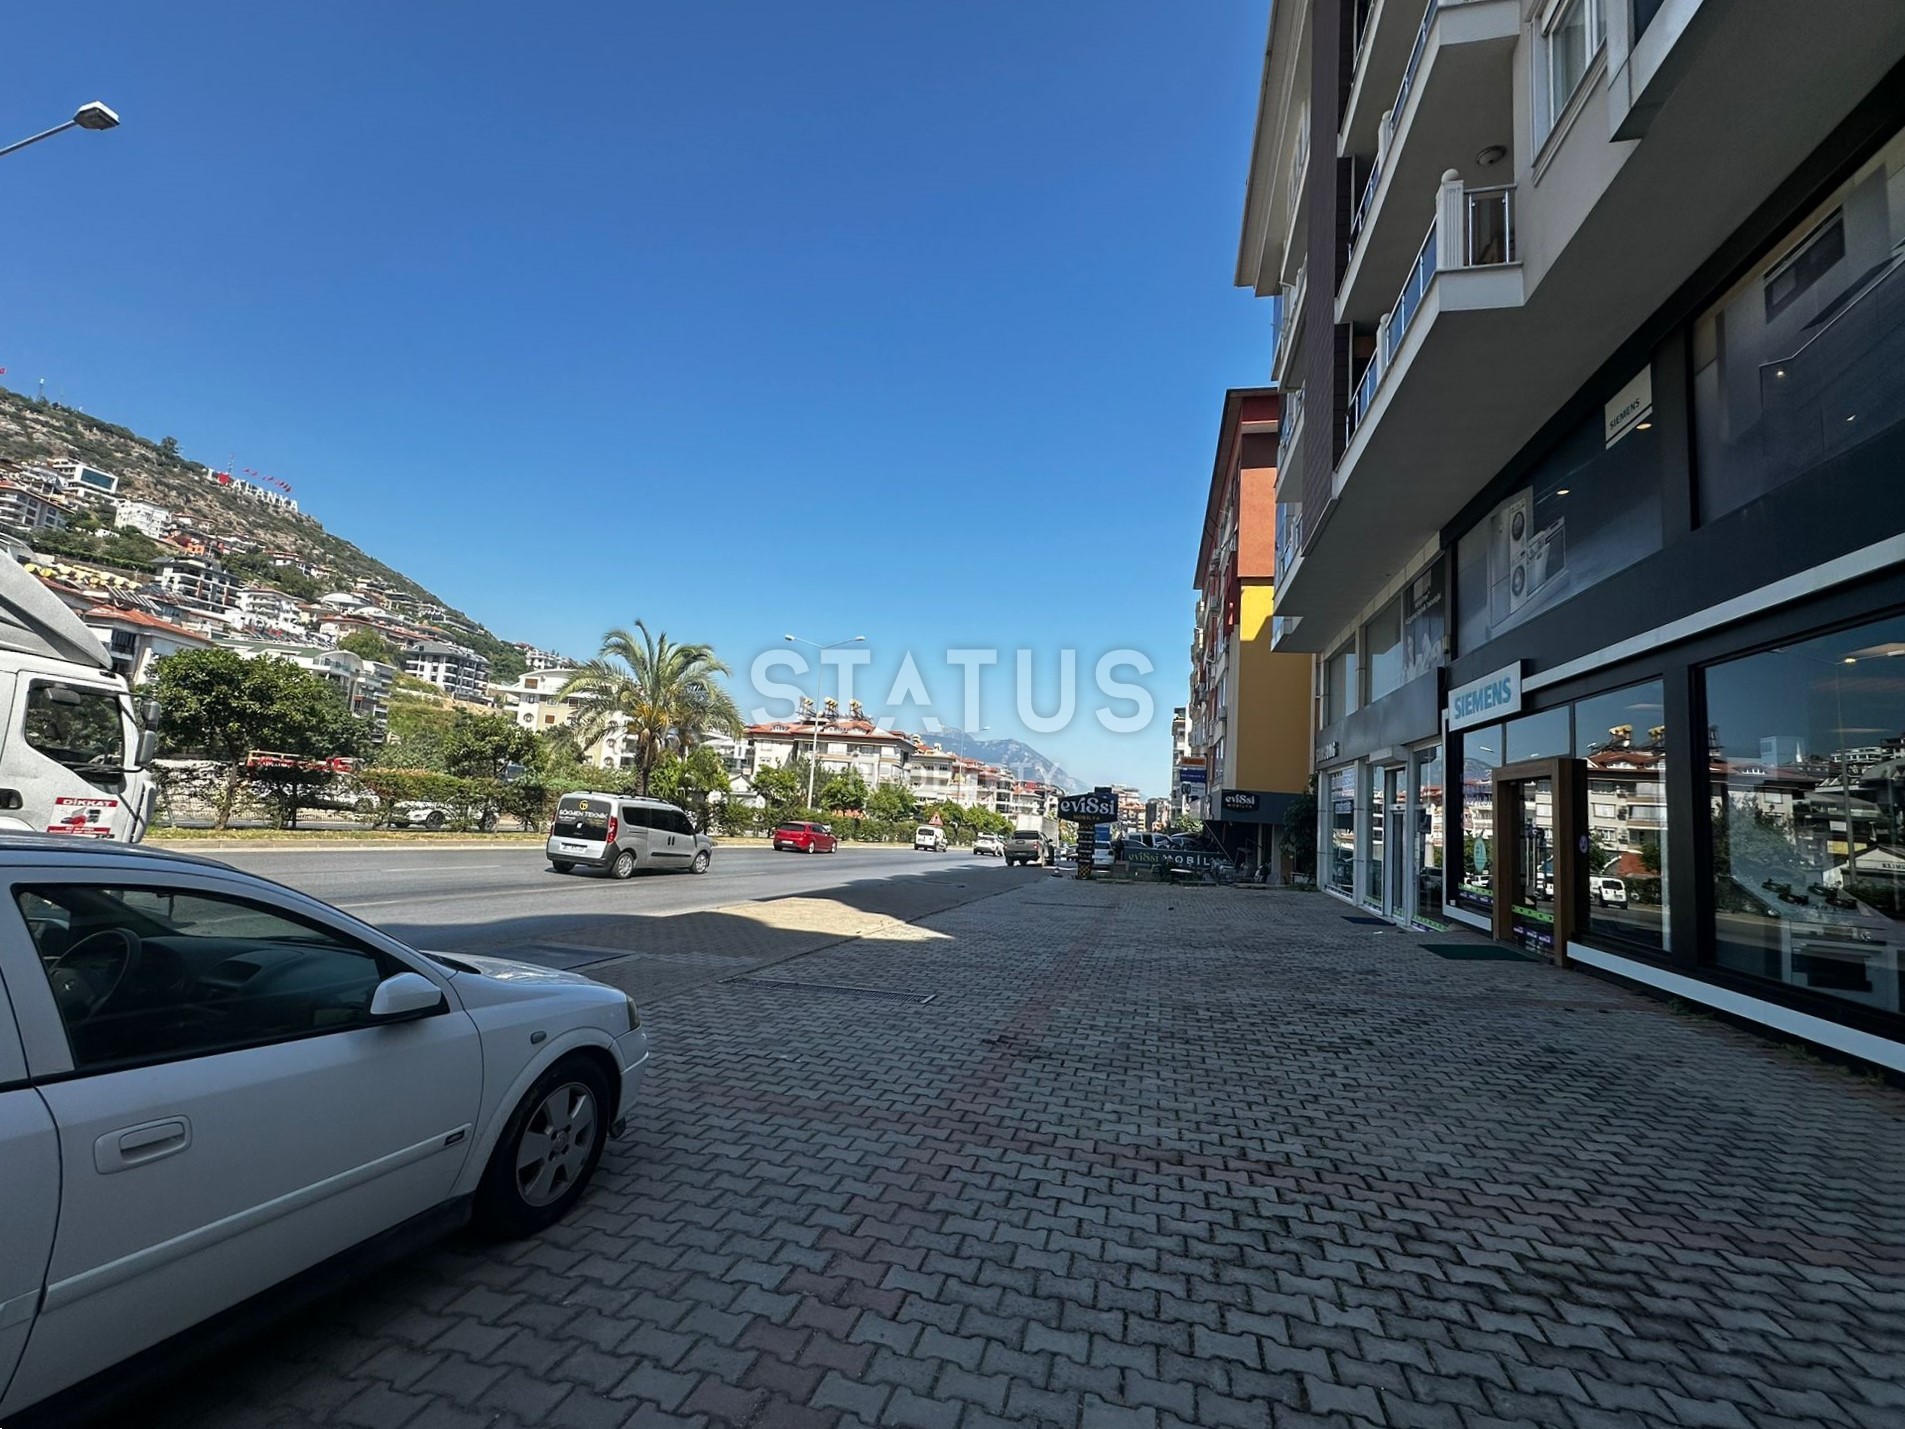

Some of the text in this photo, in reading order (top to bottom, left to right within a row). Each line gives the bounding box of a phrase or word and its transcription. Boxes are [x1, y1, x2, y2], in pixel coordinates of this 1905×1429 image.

[1609, 398, 1641, 430] SIEMENS
[231, 478, 299, 513] ALANYA
[1454, 677, 1512, 720] SIEMENS
